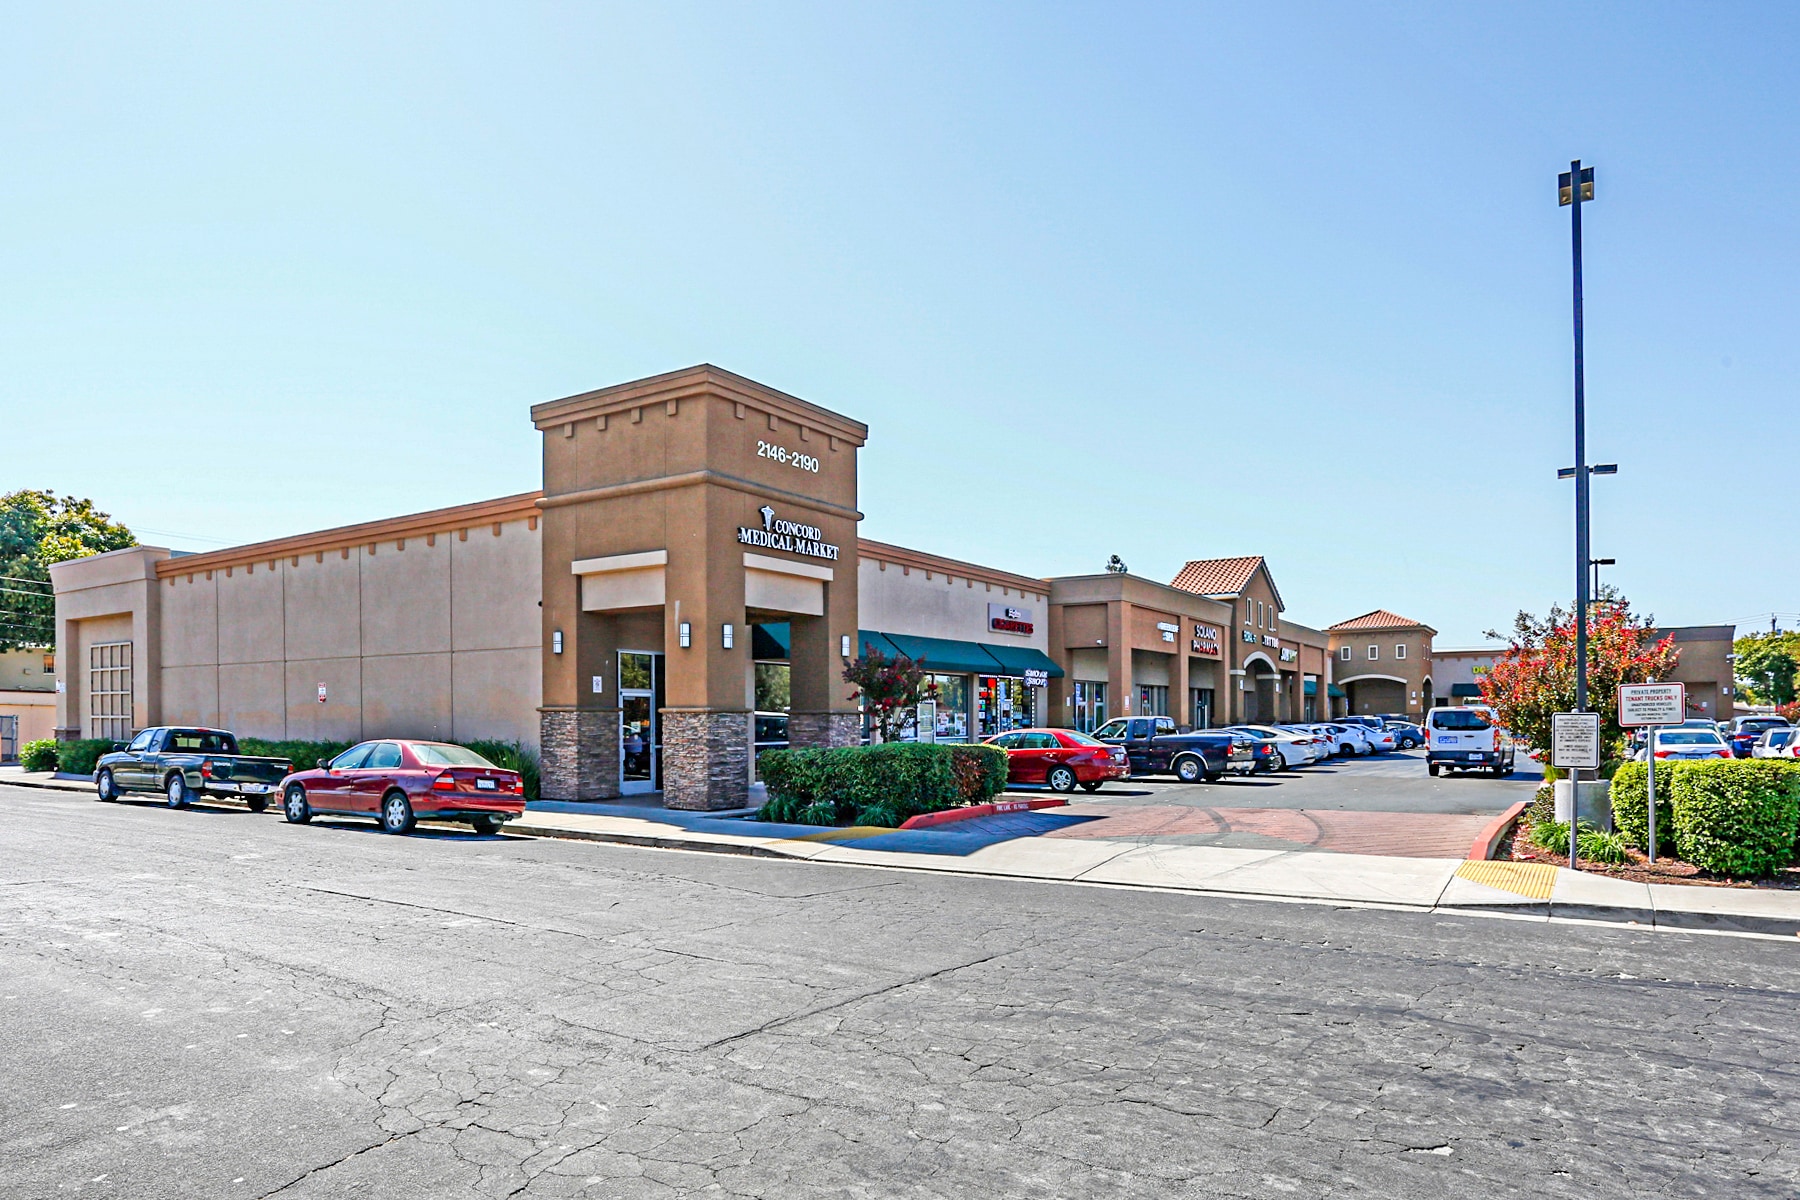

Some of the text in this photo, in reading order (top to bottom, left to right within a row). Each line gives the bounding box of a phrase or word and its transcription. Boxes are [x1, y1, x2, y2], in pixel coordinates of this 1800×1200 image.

[757, 440, 819, 473] 2146-2190
[774, 519, 822, 541] CONCORD
[739, 526, 840, 561] MEDICAL MARKET
[1195, 624, 1217, 641] SOLANO
[1192, 640, 1220, 656] PHARMACY
